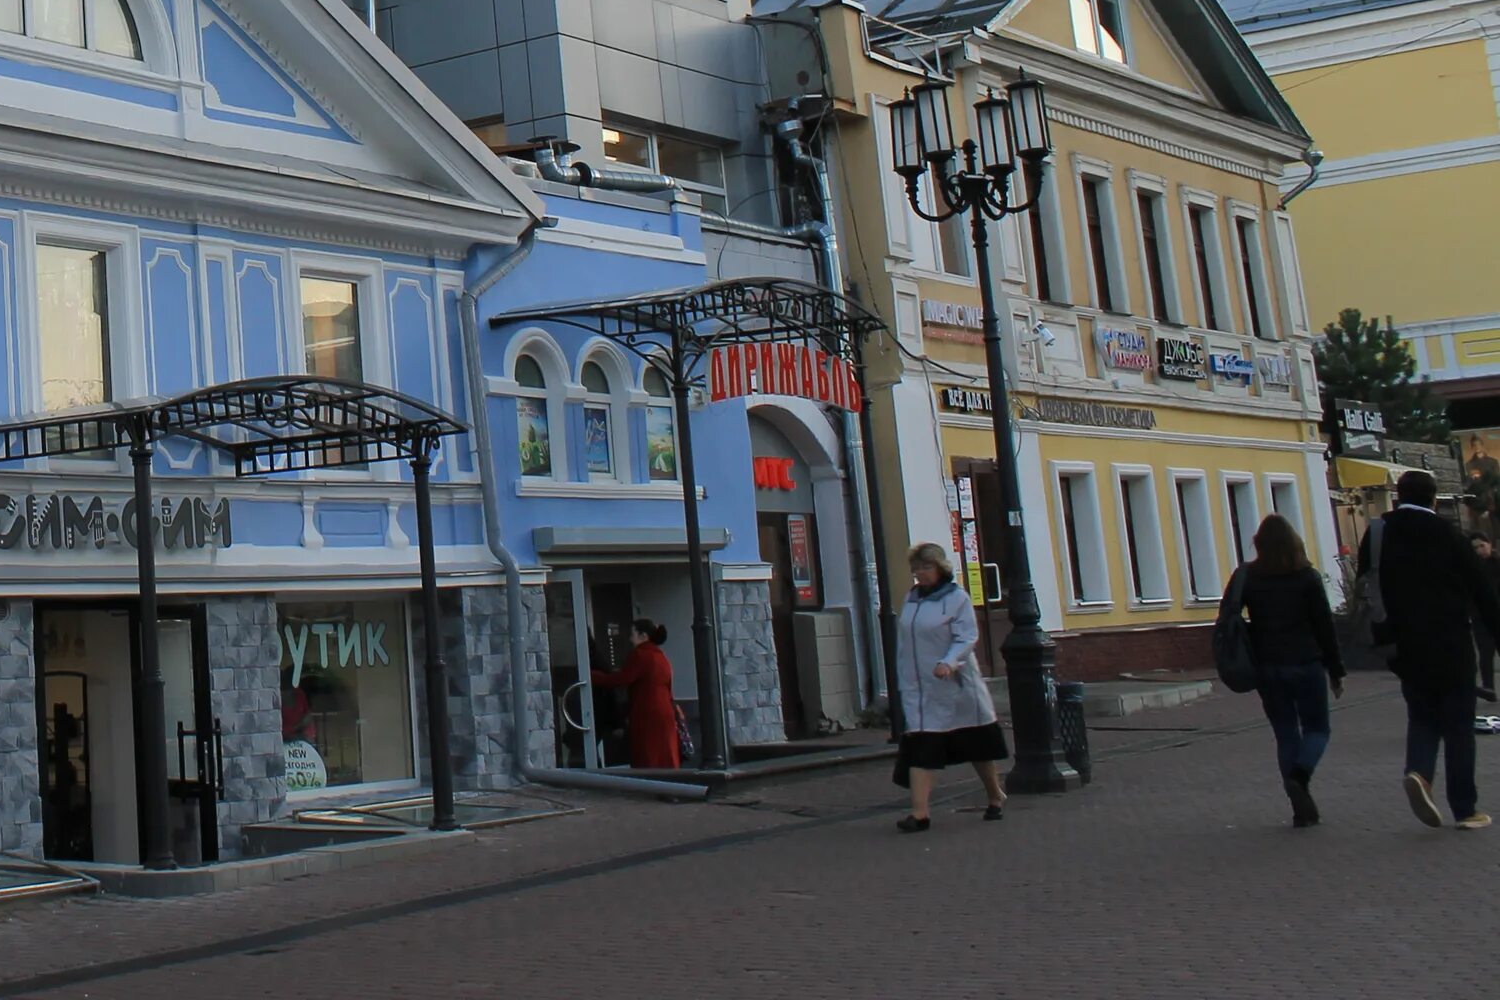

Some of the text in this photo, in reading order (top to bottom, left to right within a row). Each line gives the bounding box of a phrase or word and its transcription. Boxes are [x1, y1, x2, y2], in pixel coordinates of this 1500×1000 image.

[711, 343, 862, 413] ДИРИЖАБЛЬ
[277, 622, 389, 688] УТИК
[288, 749, 307, 758] NEW
